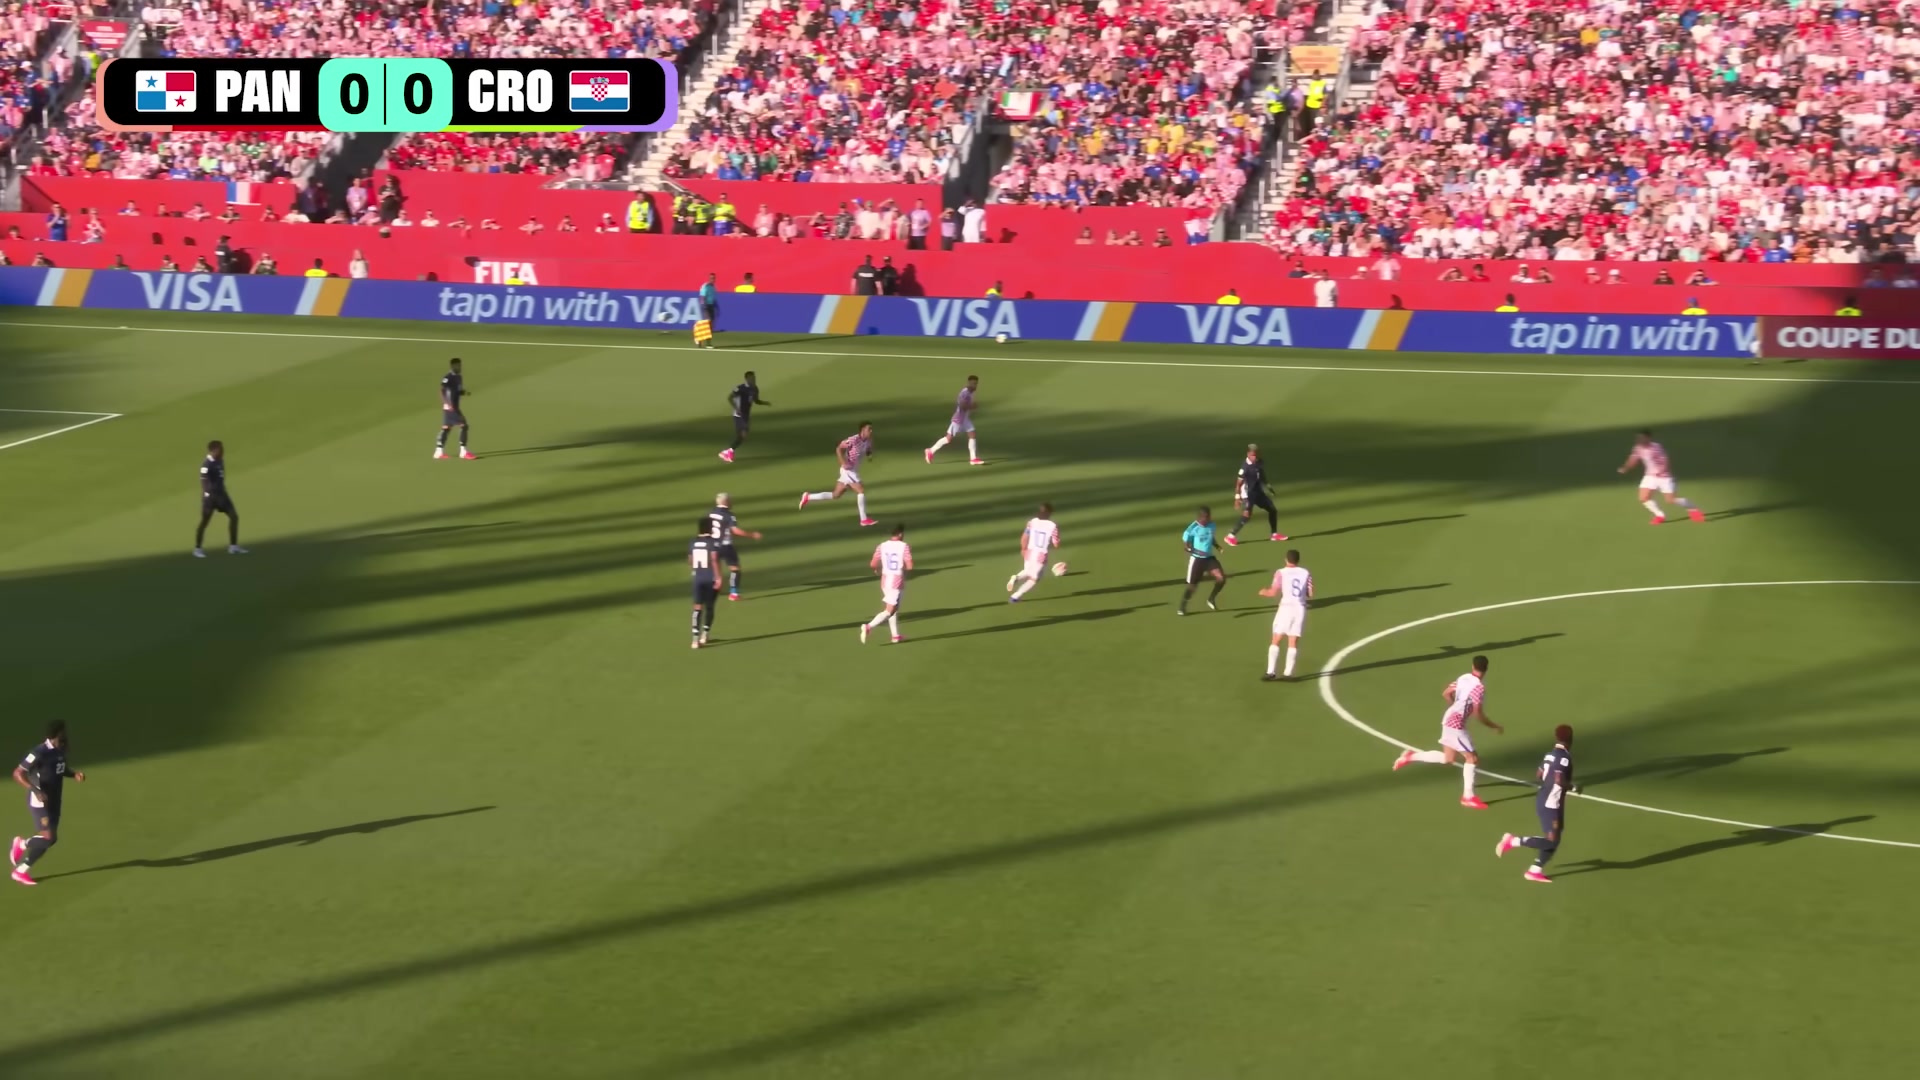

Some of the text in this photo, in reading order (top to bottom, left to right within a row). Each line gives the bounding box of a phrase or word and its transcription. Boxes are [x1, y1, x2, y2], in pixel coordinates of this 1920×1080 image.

[475, 261, 538, 285] FIFA
[131, 272, 242, 312] VISA
[439, 287, 702, 324] tap in with VISA
[907, 298, 1020, 338] VISA
[1175, 304, 1293, 346] VISA
[1510, 317, 1578, 354] tap
[1581, 316, 1620, 349] in
[1631, 318, 1719, 351] with
[1777, 326, 1881, 349] COUPE
[1291, 578, 1302, 597] 8
